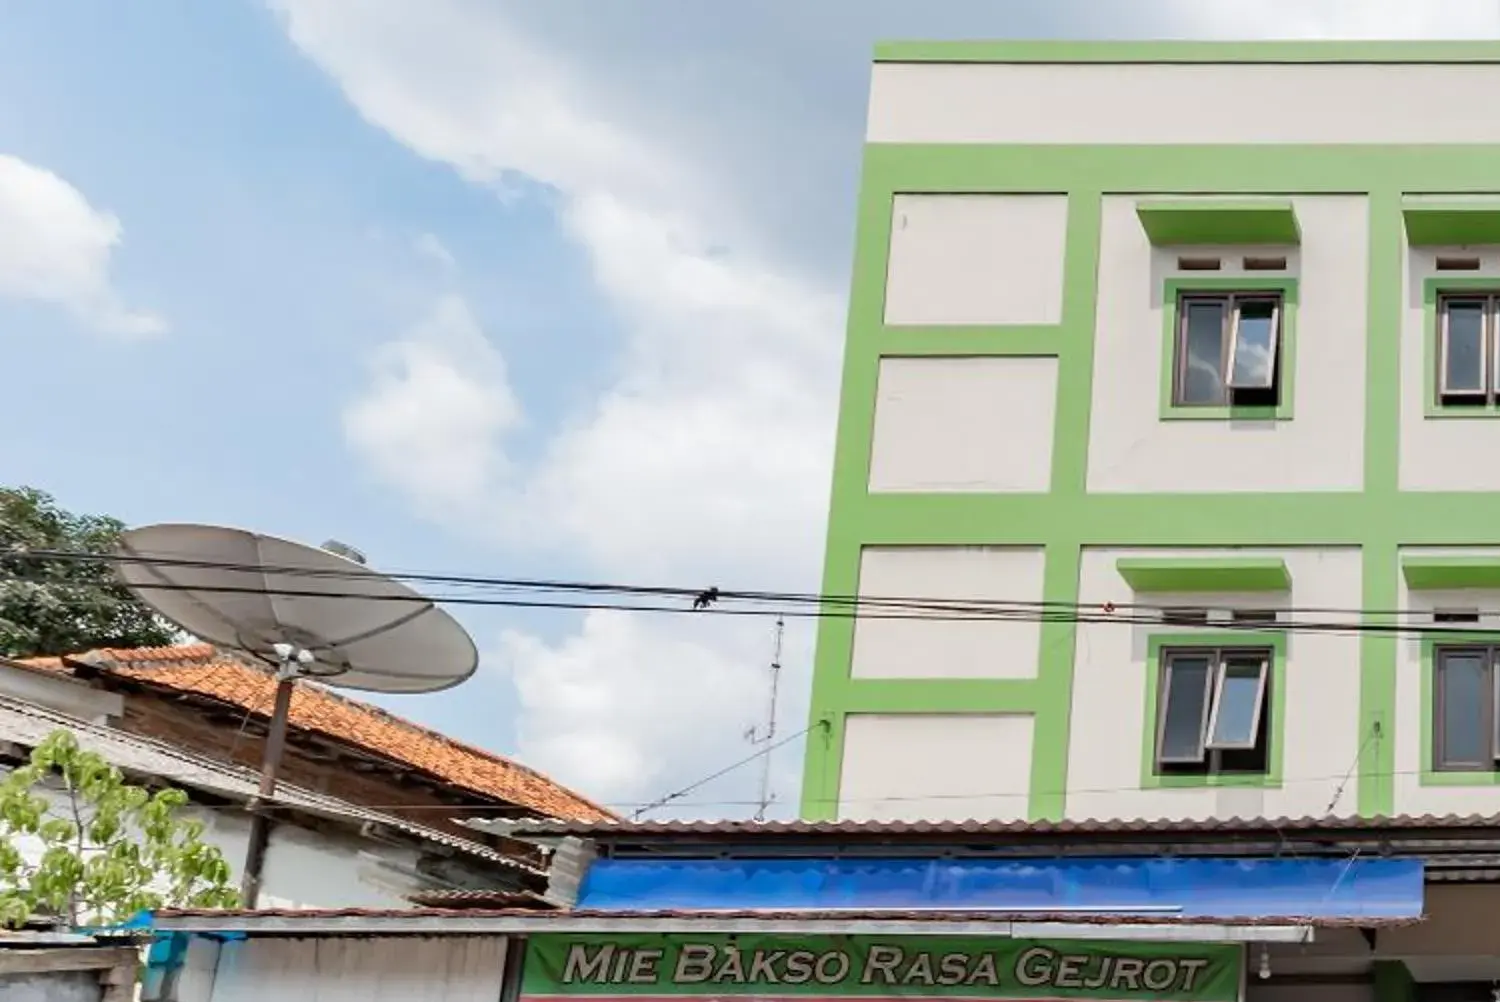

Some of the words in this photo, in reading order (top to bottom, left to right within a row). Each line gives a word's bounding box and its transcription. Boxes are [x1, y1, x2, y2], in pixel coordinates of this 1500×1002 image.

[562, 944, 662, 984] MIE
[673, 943, 850, 984] BAKSO
[861, 946, 999, 985] RASA
[1015, 948, 1207, 991] GEJROT
